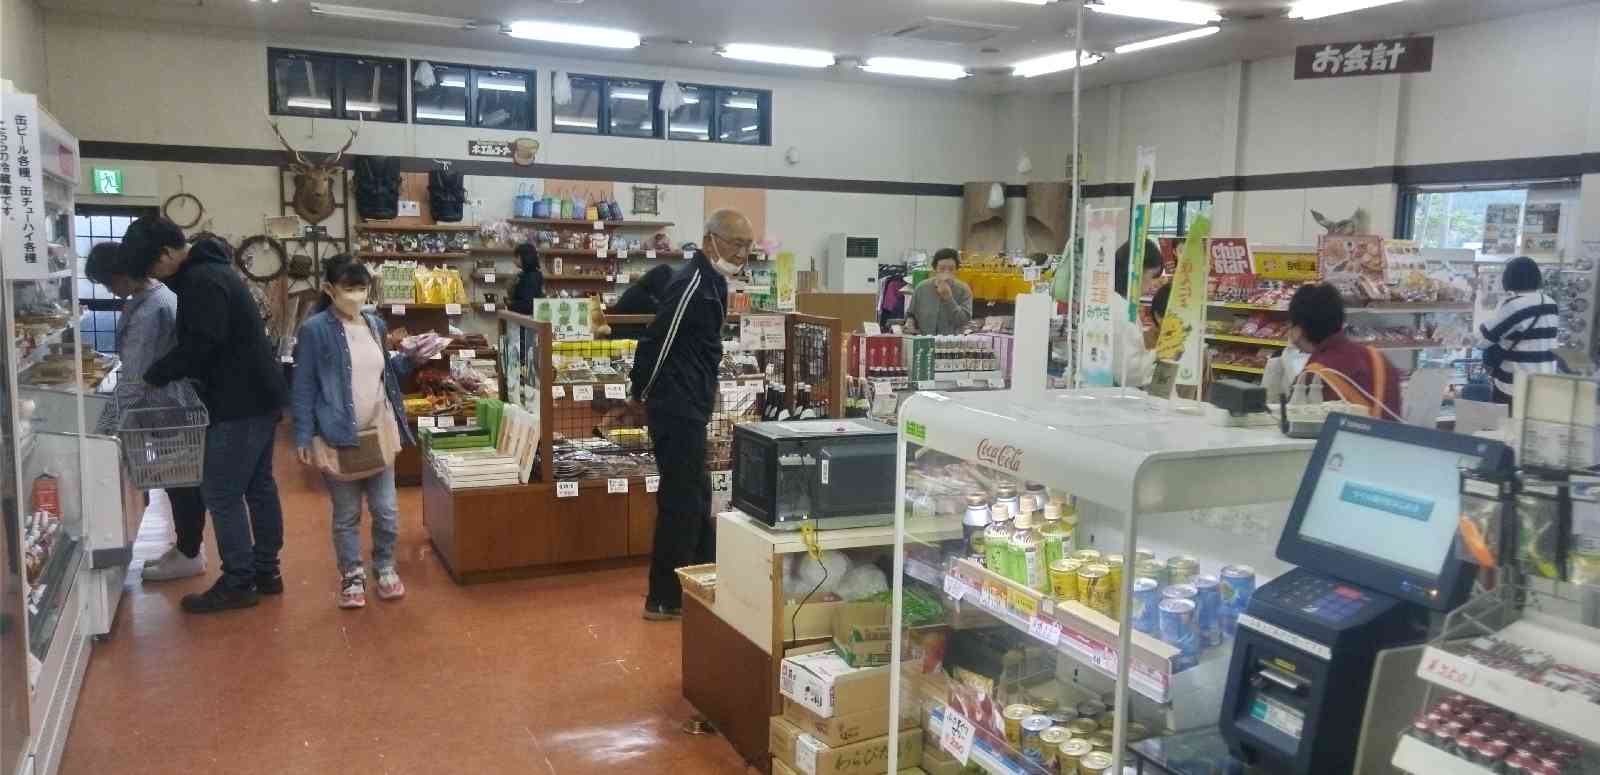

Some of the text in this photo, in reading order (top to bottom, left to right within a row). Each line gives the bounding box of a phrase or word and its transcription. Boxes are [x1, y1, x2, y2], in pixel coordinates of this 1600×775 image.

[1312, 42, 1406, 75] お会計
[14, 114, 38, 264] 缶ビール各種、缶チューハイ各種
[1211, 241, 1246, 259] chip
[1215, 257, 1249, 274] star
